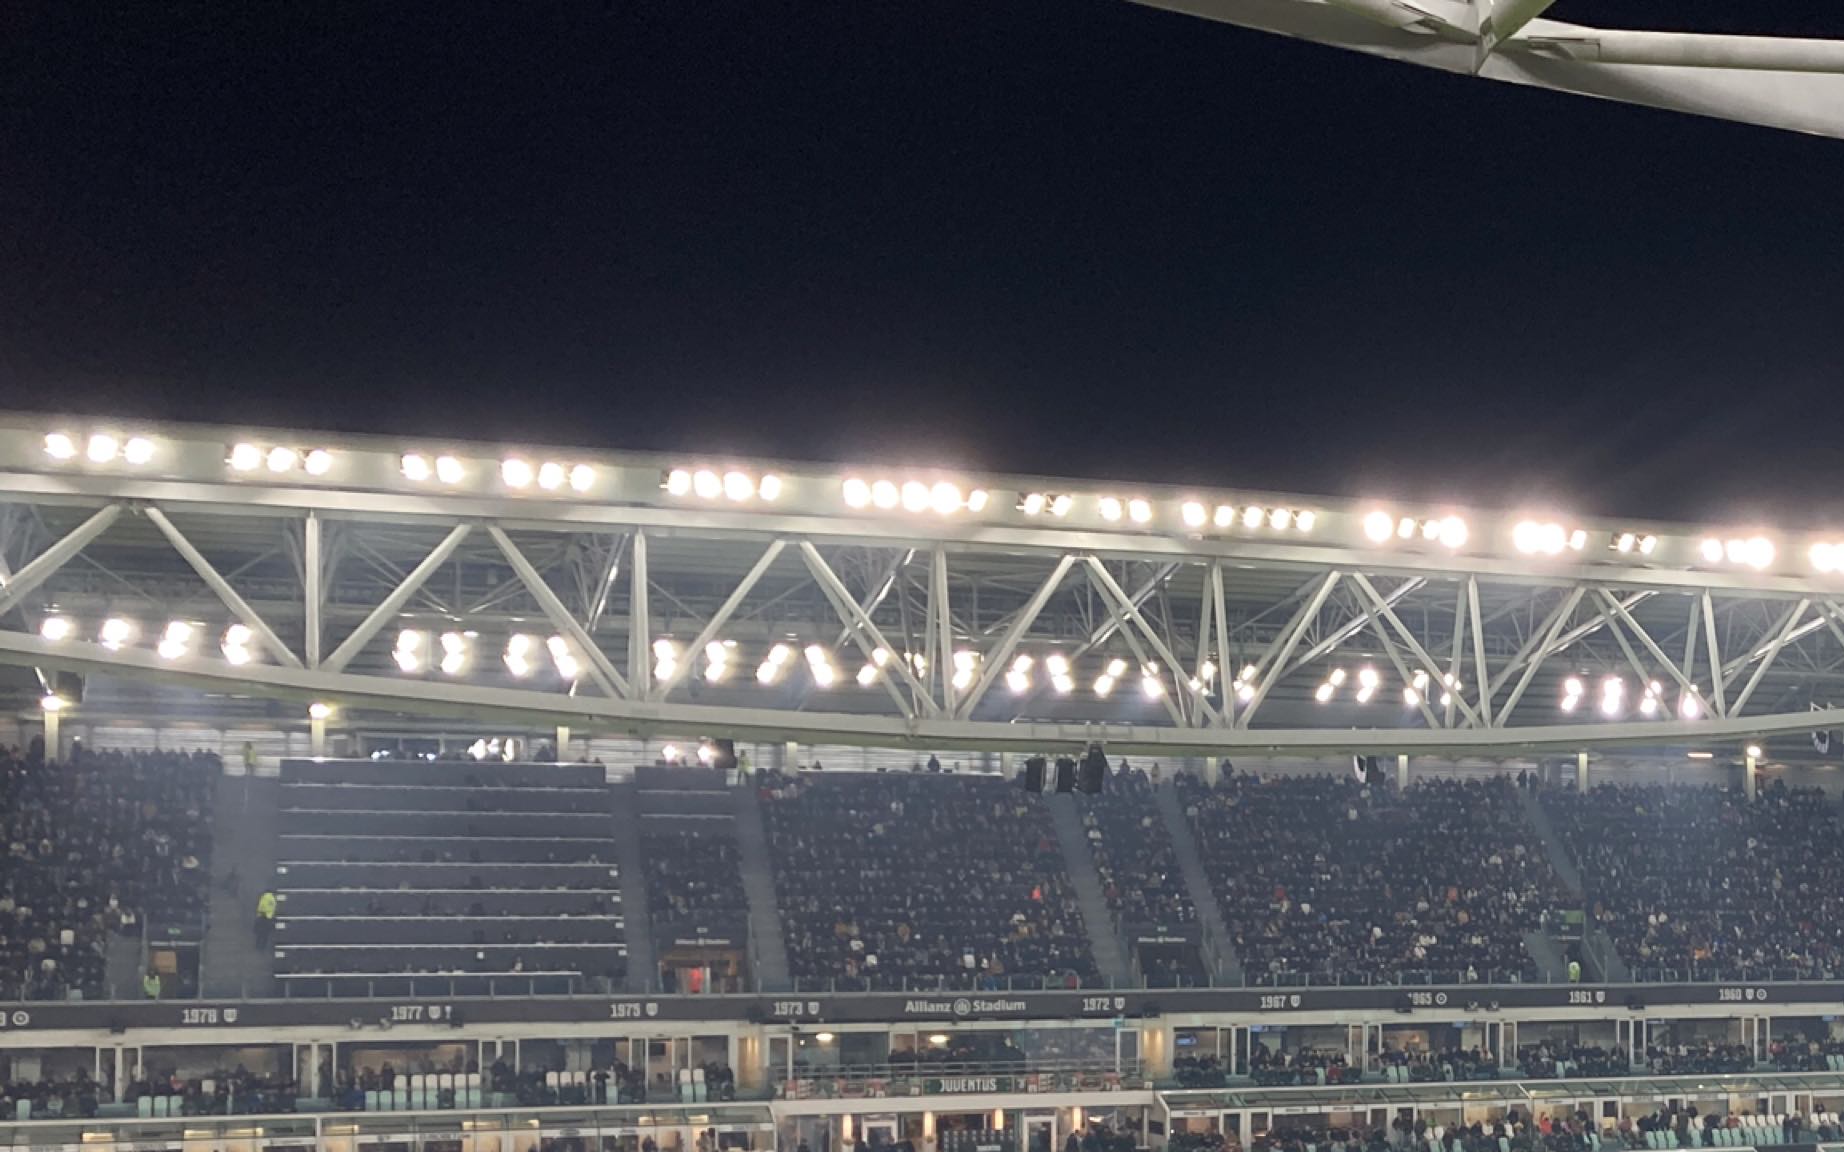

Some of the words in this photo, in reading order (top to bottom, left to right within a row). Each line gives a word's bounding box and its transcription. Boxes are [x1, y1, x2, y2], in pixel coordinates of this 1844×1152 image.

[610, 1003, 641, 1018] 1975
[773, 1001, 803, 1015] 1973
[904, 1000, 953, 1013] Allianz
[972, 999, 1026, 1012] Stadium
[1082, 998, 1110, 1011] 1972
[182, 1009, 218, 1023] 1978
[391, 1006, 424, 1020] 1977
